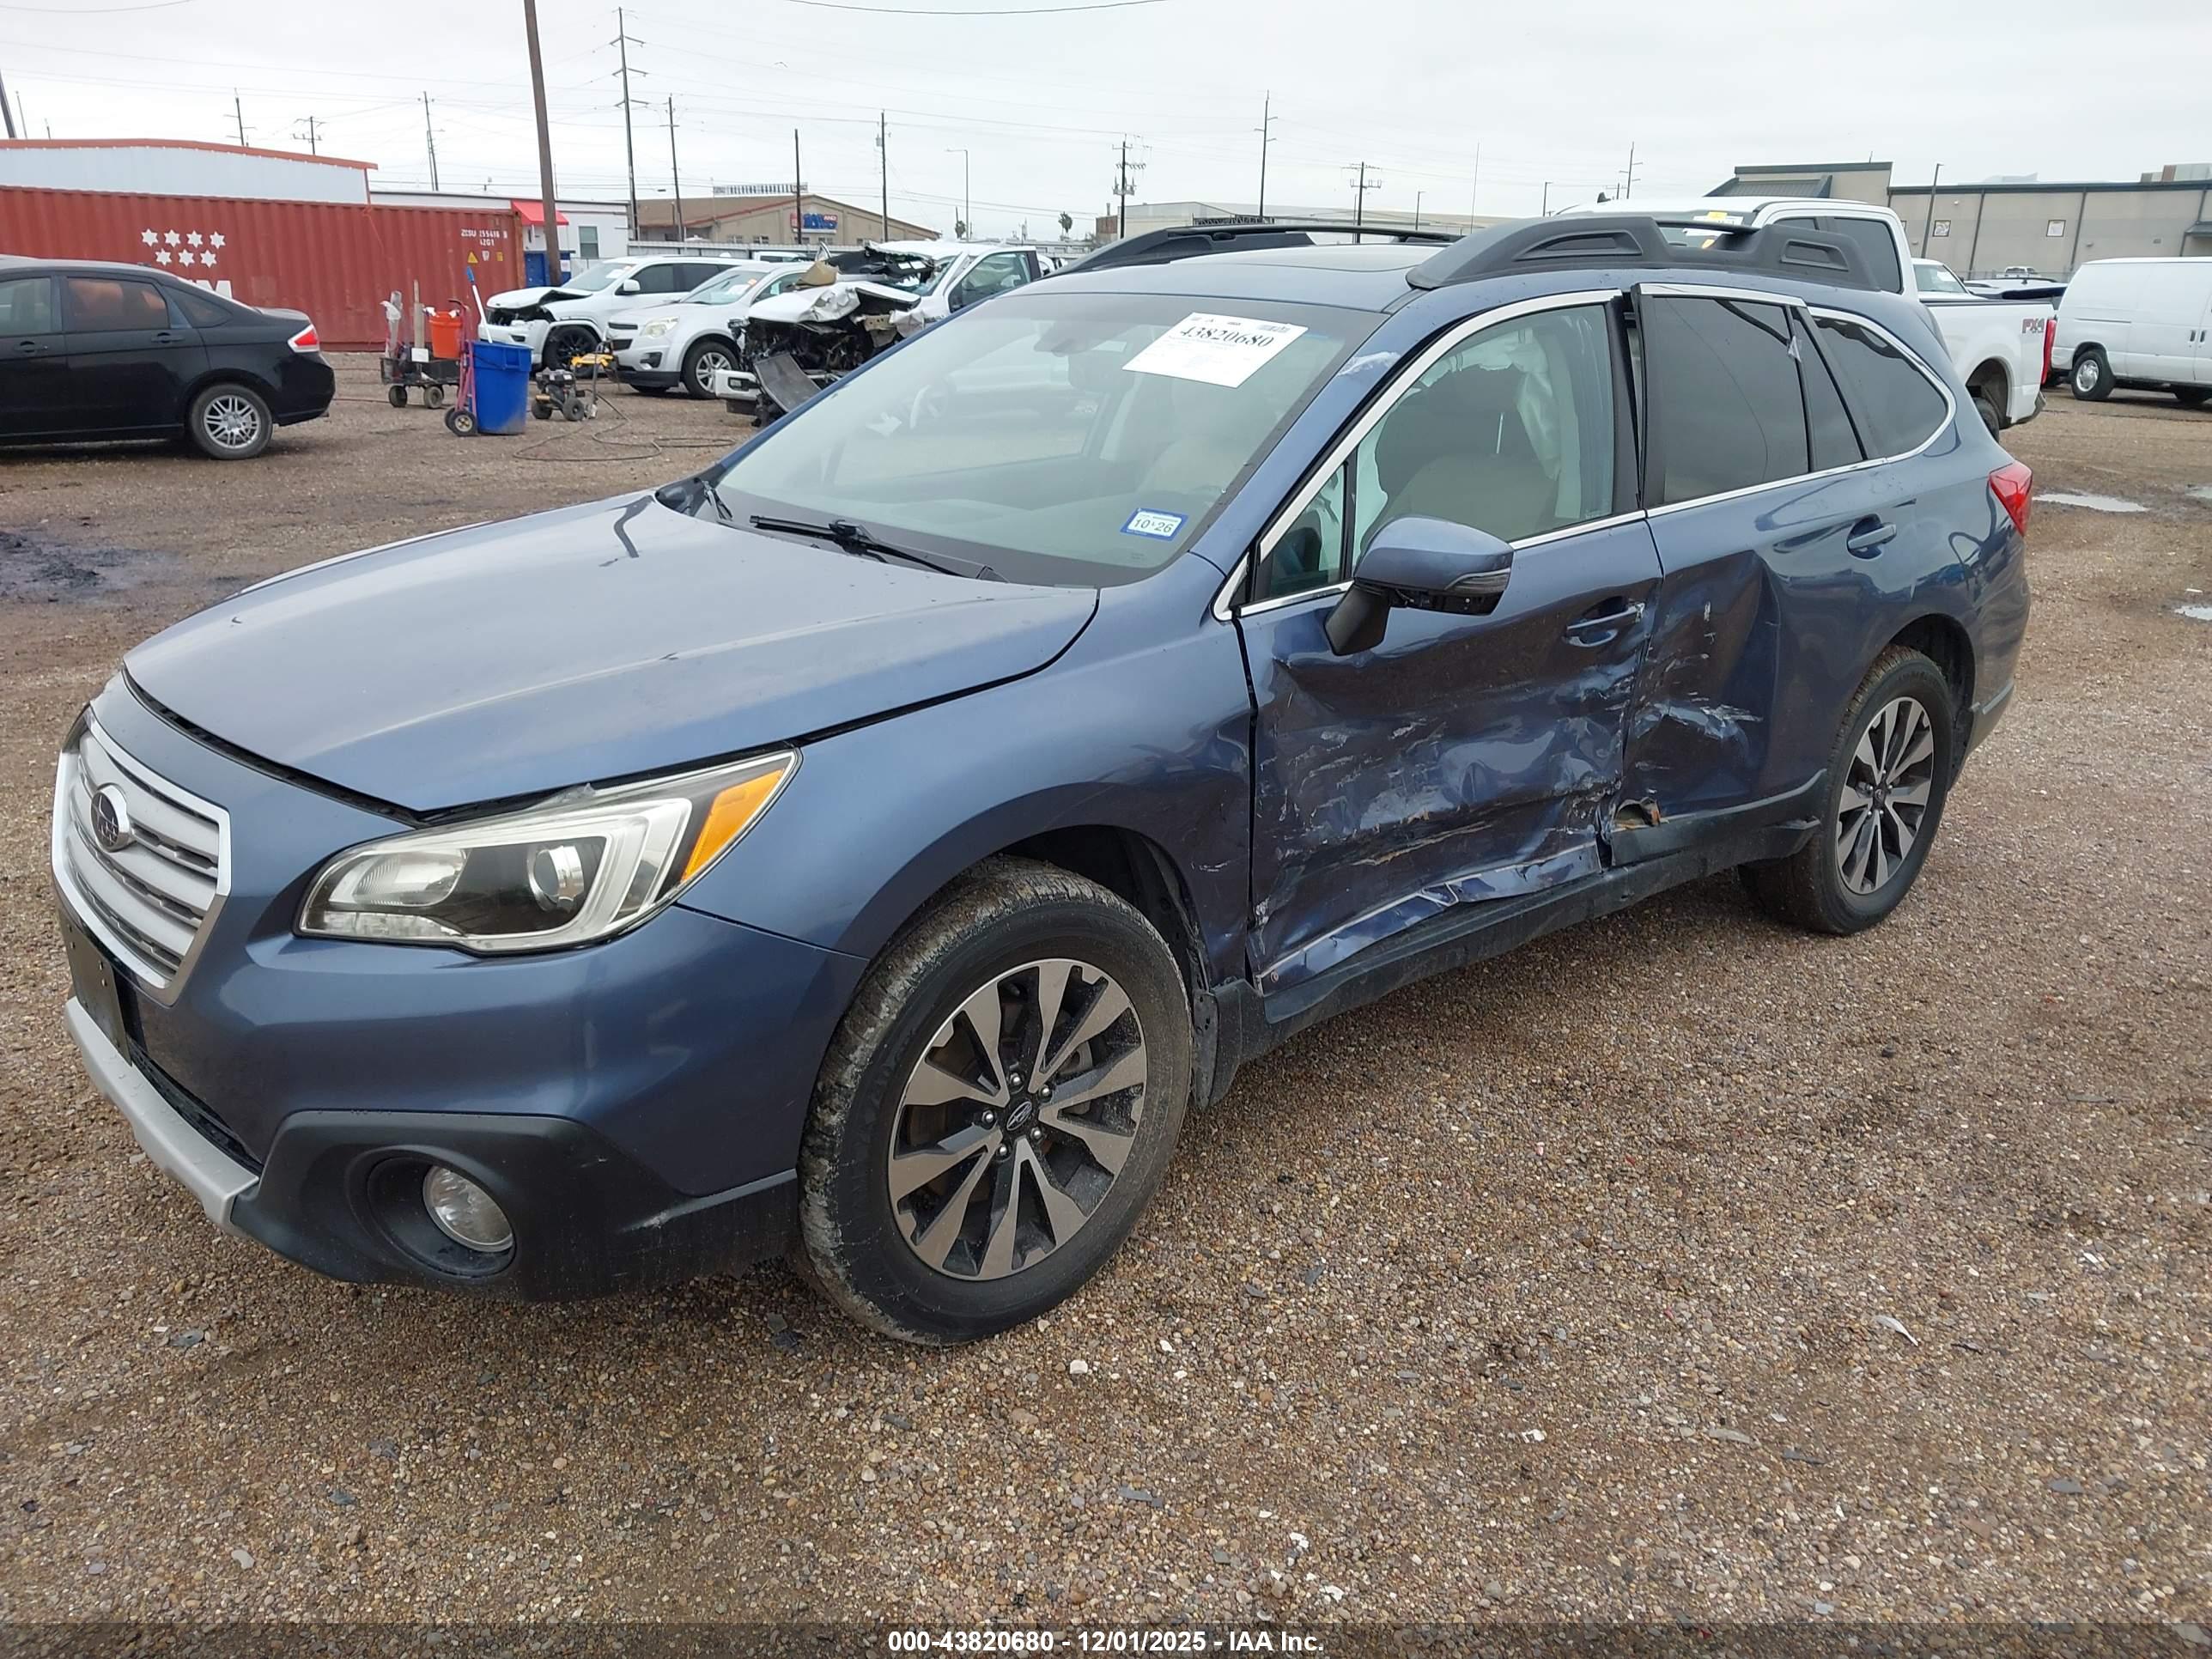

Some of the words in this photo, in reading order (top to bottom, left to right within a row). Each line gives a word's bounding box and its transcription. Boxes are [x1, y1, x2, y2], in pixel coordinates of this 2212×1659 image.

[2022, 318, 2045, 333] FX4
[1180, 325, 1275, 348] 43820680
[1134, 519, 1151, 529] 10
[1154, 521, 1174, 532] 26
